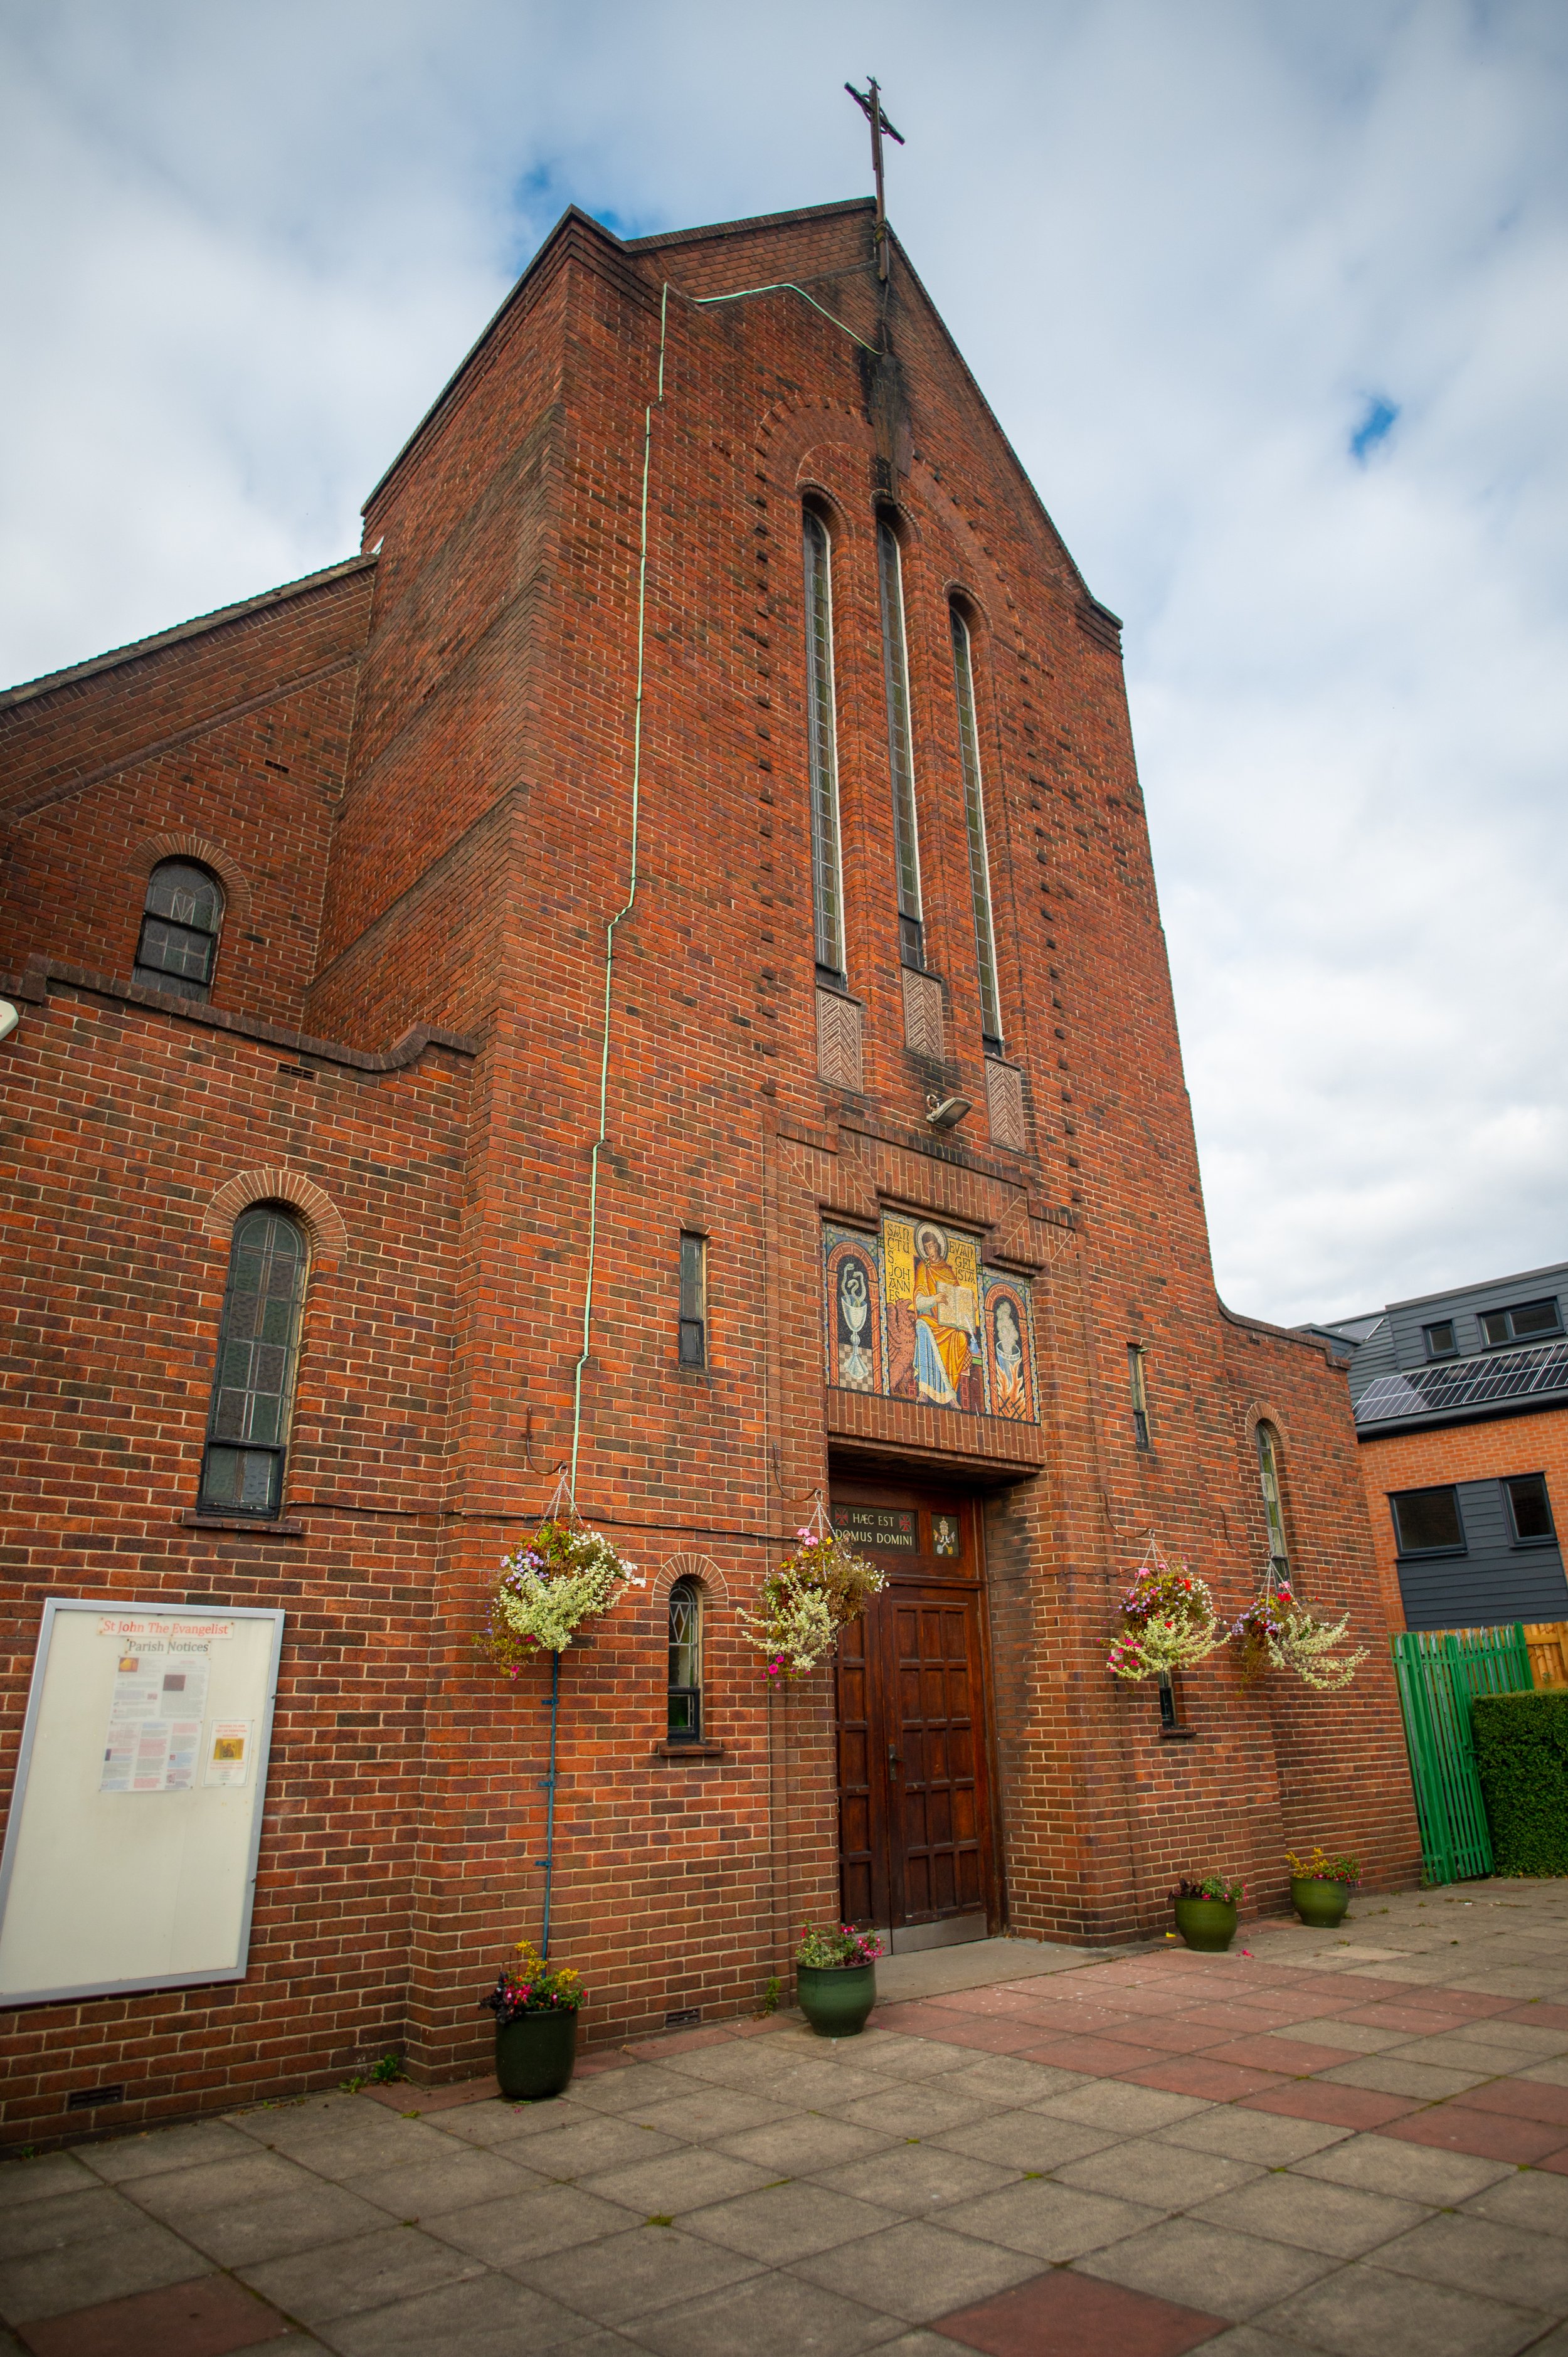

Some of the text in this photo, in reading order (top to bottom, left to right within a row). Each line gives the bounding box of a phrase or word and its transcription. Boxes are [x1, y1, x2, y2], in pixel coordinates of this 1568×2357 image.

[955, 1256, 974, 1271] GEL
[888, 1265, 910, 1281] JOH
[888, 1278, 910, 1292] ANN
[889, 1290, 899, 1301] ES
[878, 1515, 894, 1527] EST
[877, 1533, 912, 1546] DOMINI
[103, 1621, 228, 1637] St John The Evangelist
[128, 1641, 209, 1653] Parish Notices
